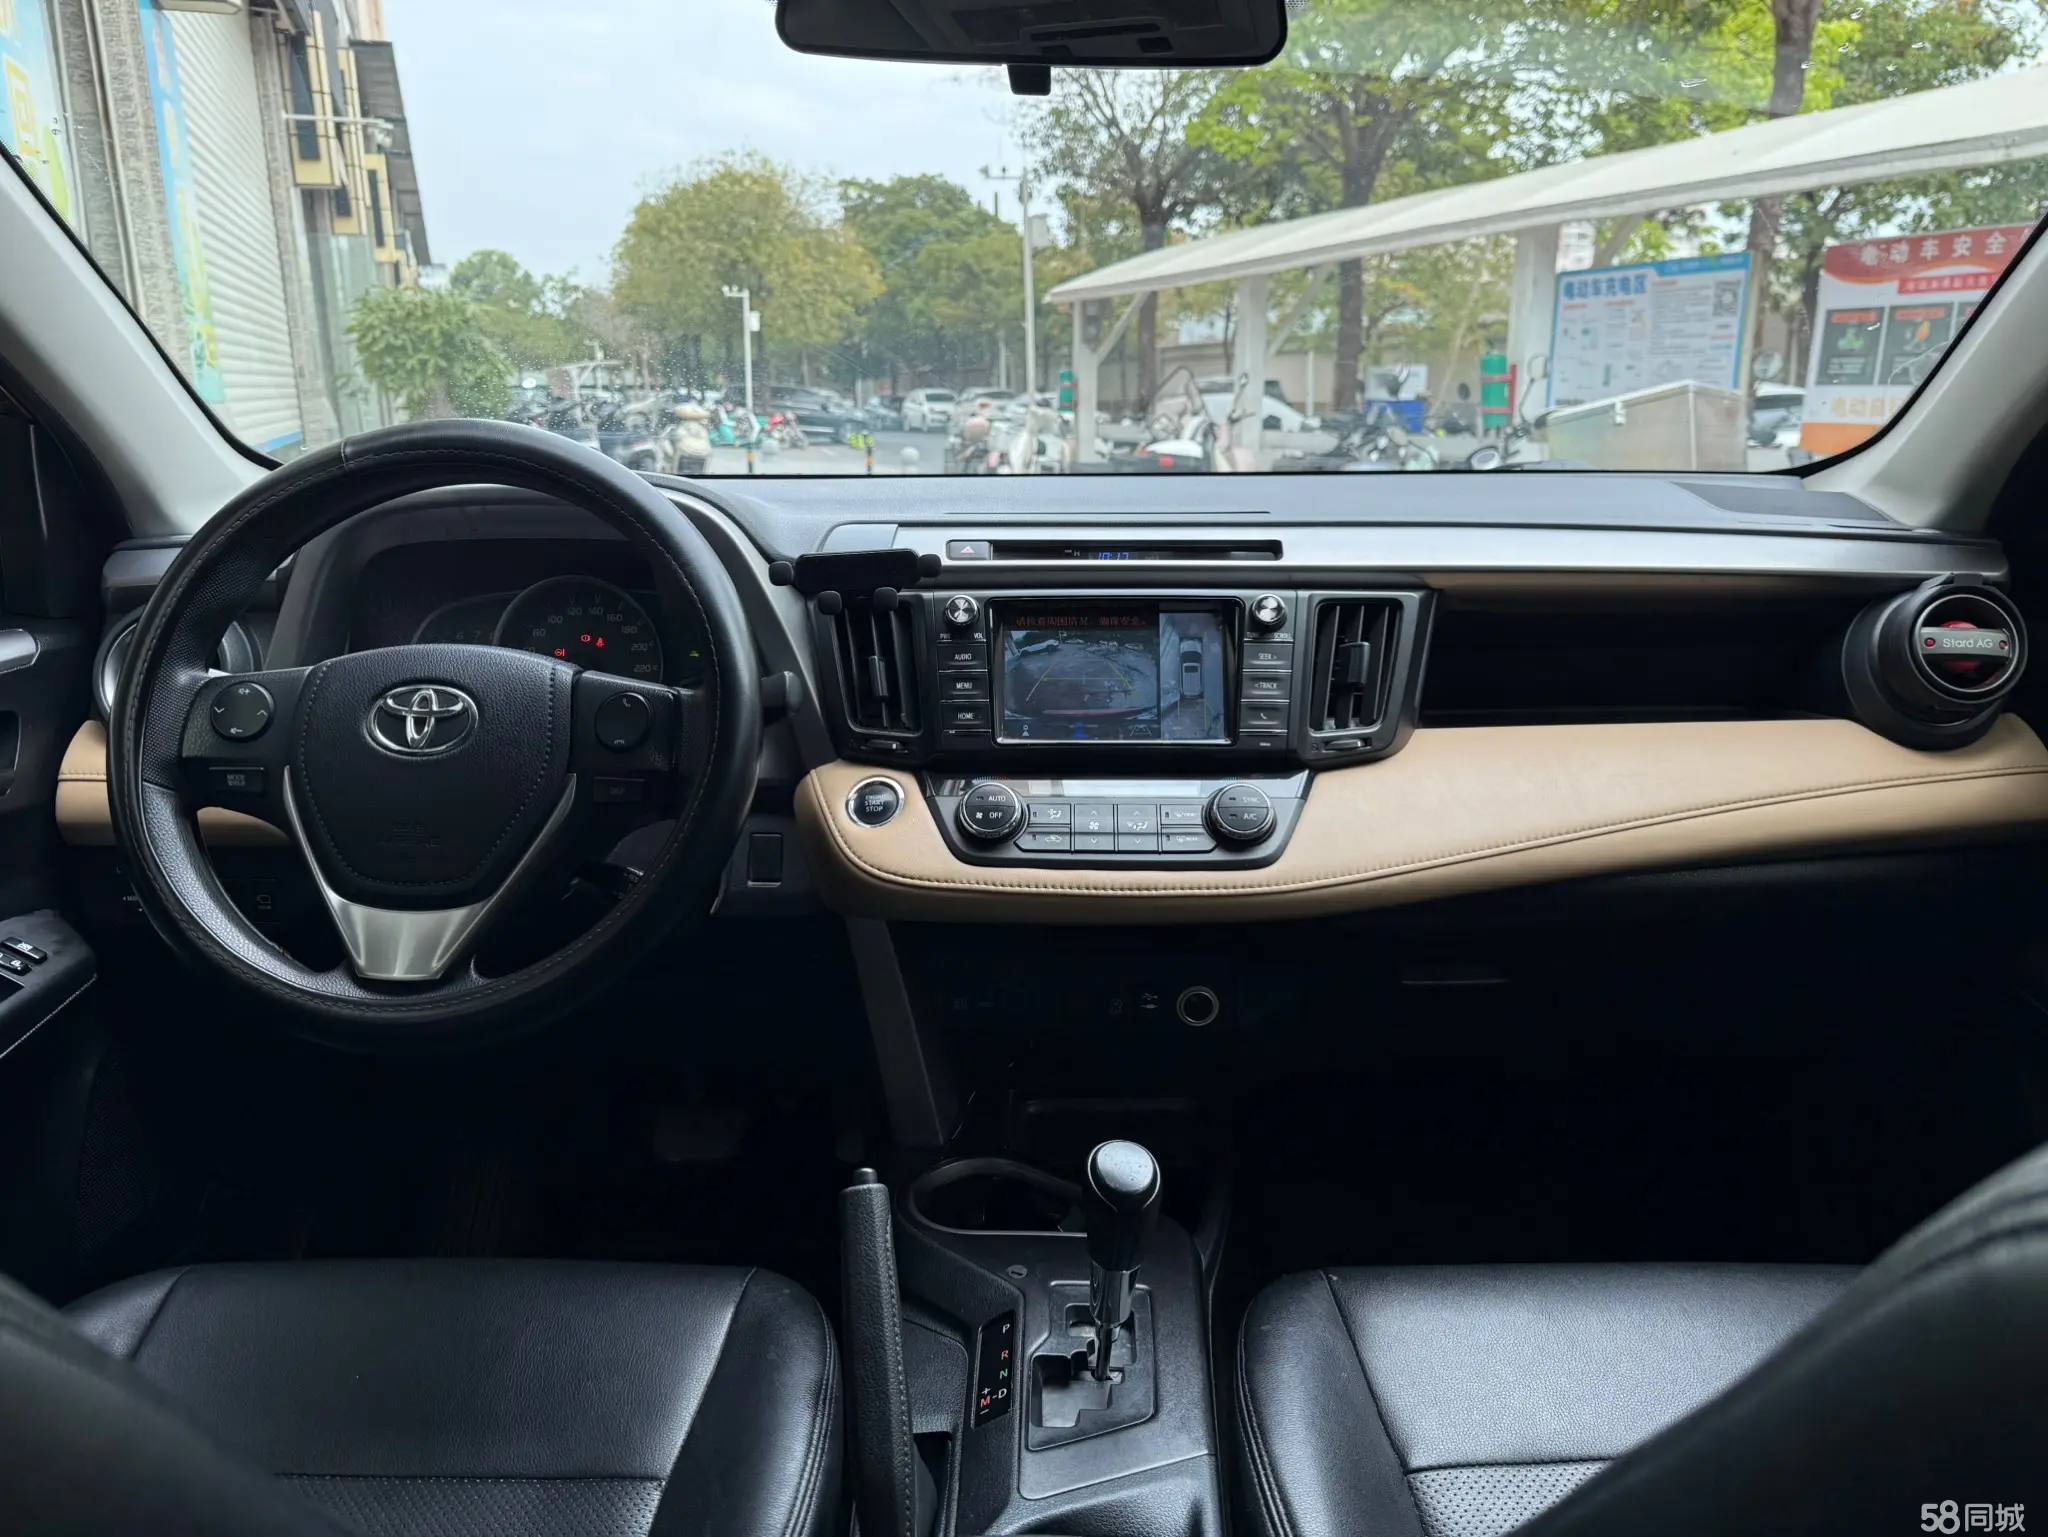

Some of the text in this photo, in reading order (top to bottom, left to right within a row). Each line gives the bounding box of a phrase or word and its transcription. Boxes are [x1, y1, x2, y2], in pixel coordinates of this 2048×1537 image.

[1860, 228, 2030, 266] 电动车安全
[607, 613, 623, 622] 160
[1943, 638, 1993, 648] Stard AG
[957, 712, 974, 720] HOME
[989, 811, 1003, 819] OFF
[1243, 812, 1257, 820] A/C
[1002, 1323, 1011, 1334] P
[1001, 1350, 1009, 1360] R
[999, 1368, 1008, 1379] N
[998, 1388, 1007, 1399] D
[980, 1395, 991, 1407] M
